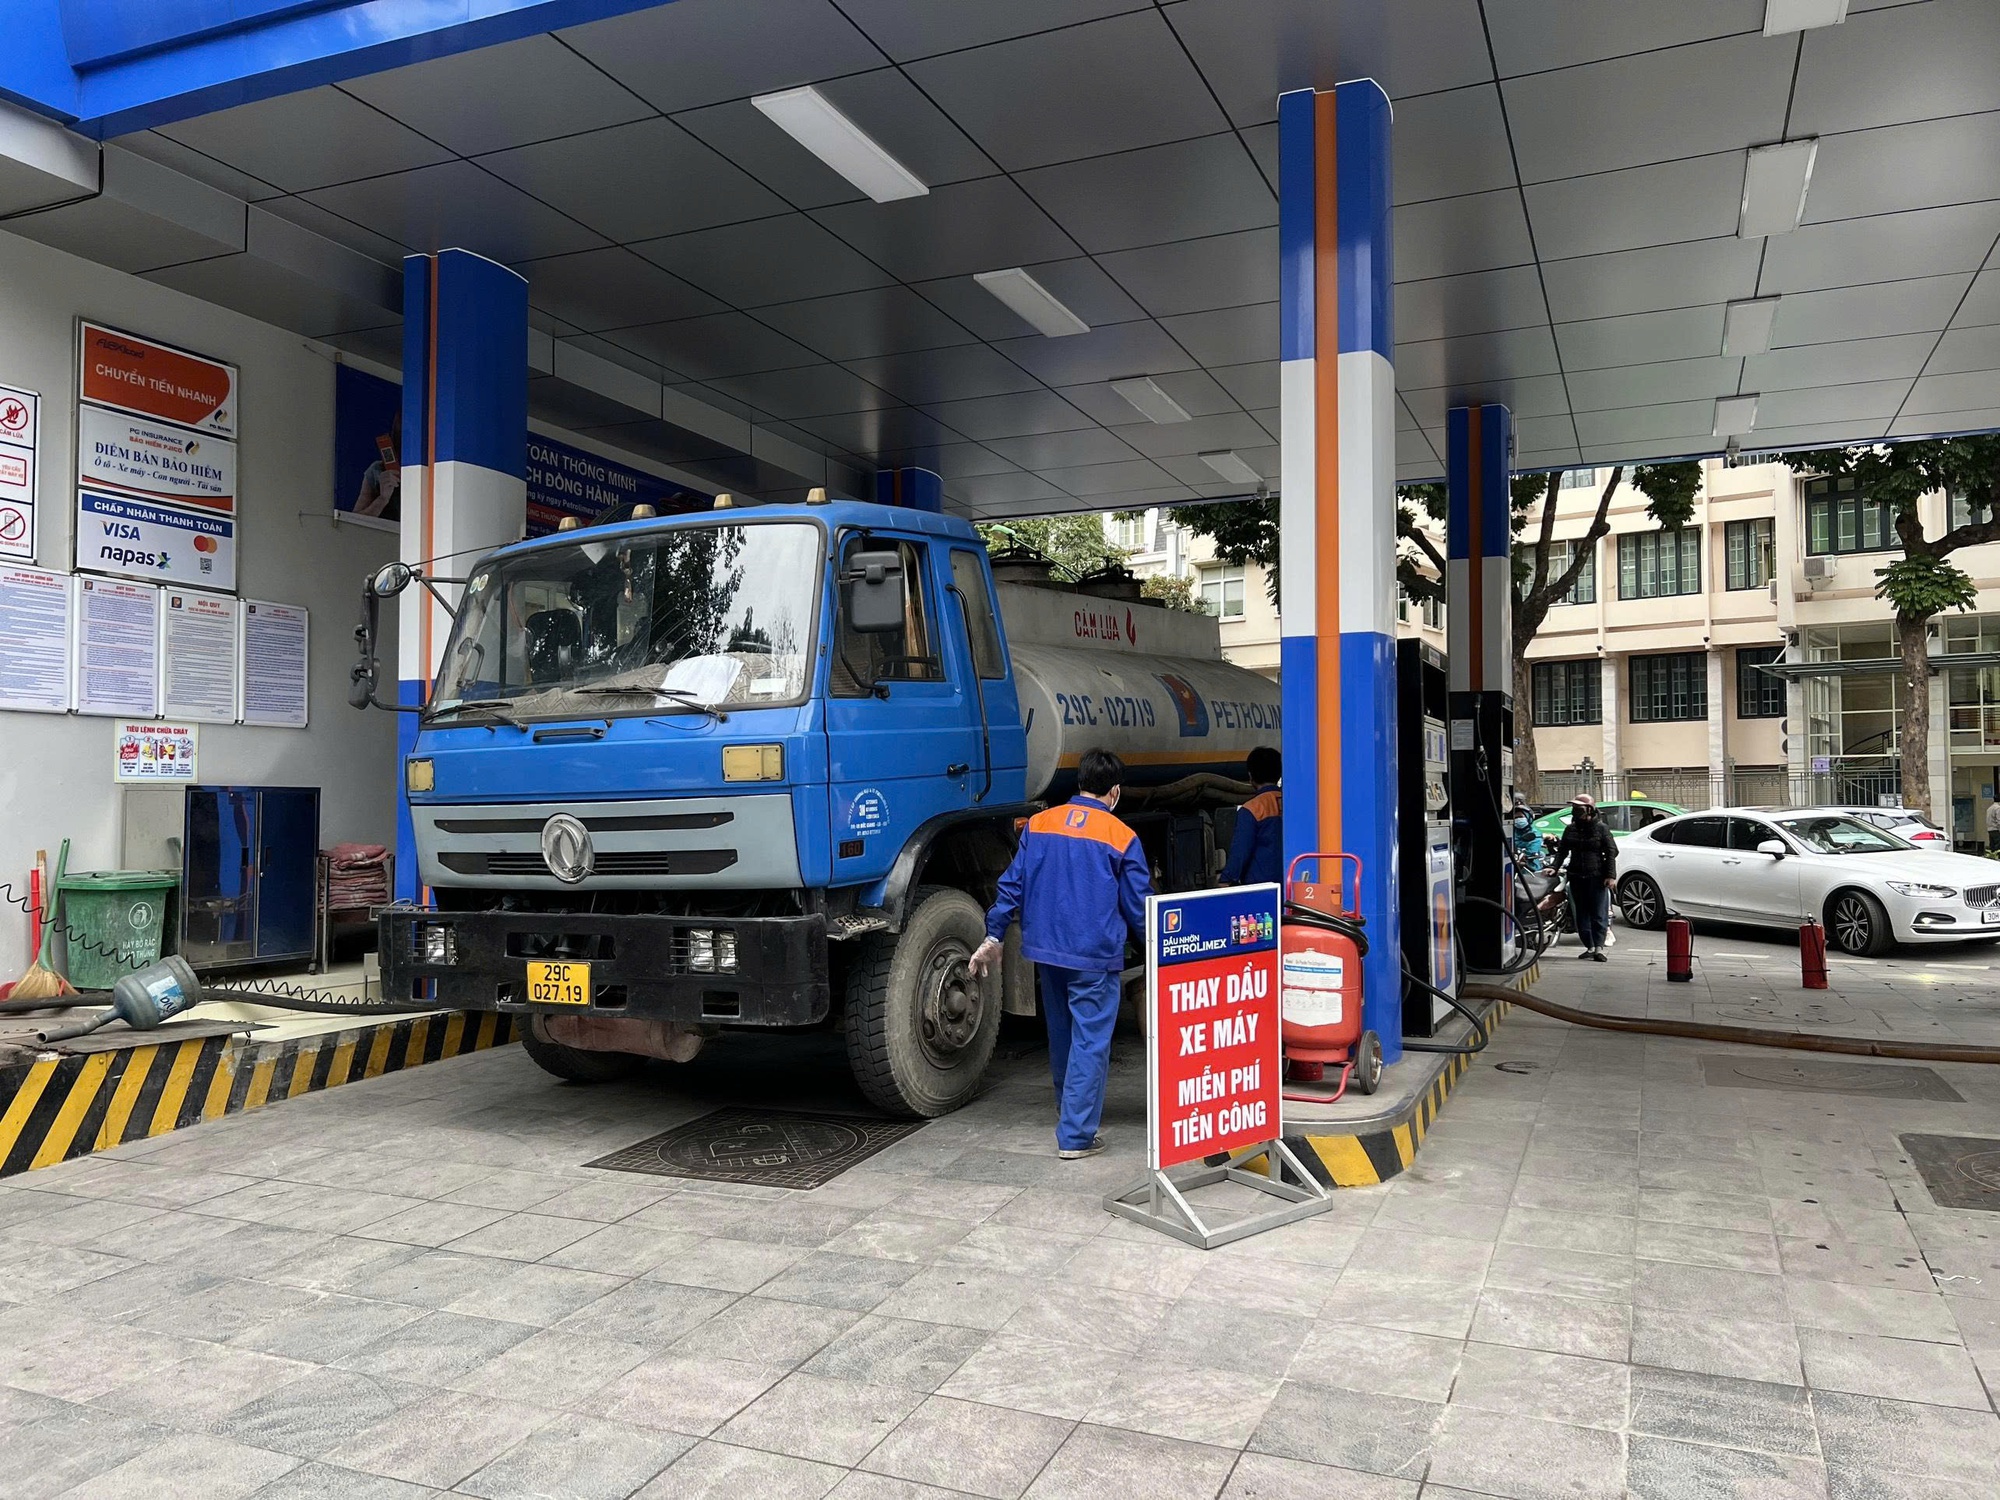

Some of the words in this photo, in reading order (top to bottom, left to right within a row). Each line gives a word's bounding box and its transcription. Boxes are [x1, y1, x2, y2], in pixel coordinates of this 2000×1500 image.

[96, 363, 145, 387] CHUYỂN
[177, 386, 216, 406] NHANH
[129, 427, 140, 435] PG
[141, 430, 183, 445] INSURANCE
[94, 455, 102, 467] Ô
[103, 460, 111, 469] tô
[118, 462, 129, 473] Xe
[130, 465, 146, 478] máy
[152, 471, 168, 481] Con
[95, 441, 129, 460] ĐIỂM
[133, 450, 159, 466] BÁN
[162, 456, 188, 473] BẢO
[191, 463, 222, 481] HIỂM
[562, 455, 605, 482] THÔNG
[608, 470, 637, 492] MINH
[545, 472, 583, 496] ĐỒNG
[586, 484, 619, 506] HÀNH
[94, 501, 124, 513] CHẤP
[126, 506, 156, 521] NHẬN
[159, 513, 194, 528] THANH
[196, 520, 223, 533] TOÁN
[562, 499, 594, 515] Petrolimex
[101, 520, 141, 541] VISA
[100, 545, 156, 567] napas
[126, 725, 139, 733] TIÊU
[141, 726, 155, 734] LỆNH
[1304, 886, 1314, 899] 2
[1163, 938, 1227, 957] PETROLIMEX
[544, 965, 571, 982] 29C
[534, 983, 582, 1002] 027.19
[1168, 976, 1221, 1014] THAY
[1227, 961, 1268, 1004] DẦU
[1179, 1022, 1207, 1057] XE
[1213, 1010, 1259, 1050] MÁY
[1178, 1065, 1226, 1107] MIỄN
[1230, 1058, 1261, 1095] PHÍ
[1172, 1107, 1213, 1147] TIỀN
[1218, 1101, 1267, 1136] CÔNG
